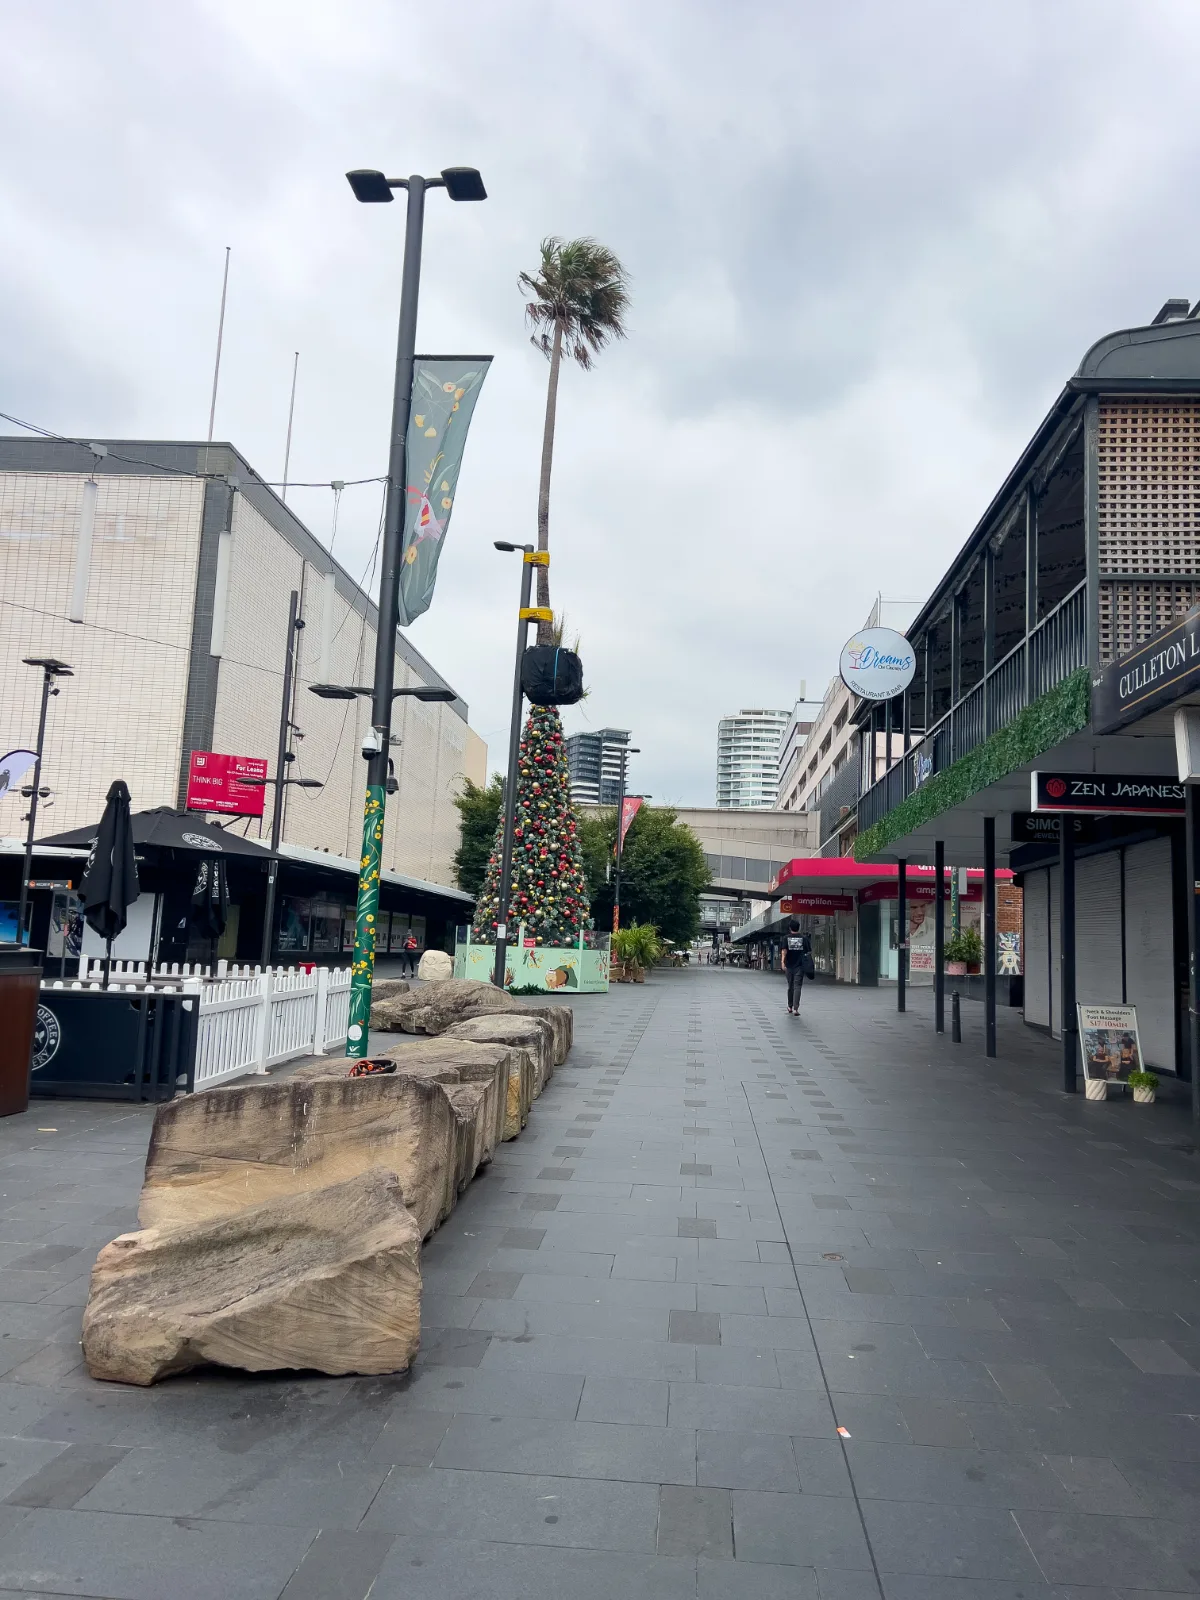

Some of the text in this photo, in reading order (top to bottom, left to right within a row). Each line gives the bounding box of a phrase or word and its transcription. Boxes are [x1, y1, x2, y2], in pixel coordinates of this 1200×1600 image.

[859, 646, 914, 670] Dreams
[1119, 637, 1187, 699] CULLETON
[850, 680, 885, 698] RESTAURANT
[890, 684, 903, 695] BAR
[246, 765, 264, 774] Lease
[193, 775, 211, 785] THINK
[212, 777, 223, 786] BIG
[1070, 781, 1106, 796] ZEN
[1026, 817, 1083, 832] SIMOS
[916, 886, 951, 895] ampo
[797, 897, 832, 906] amplifon
[37, 1008, 58, 1038] OFFEE
